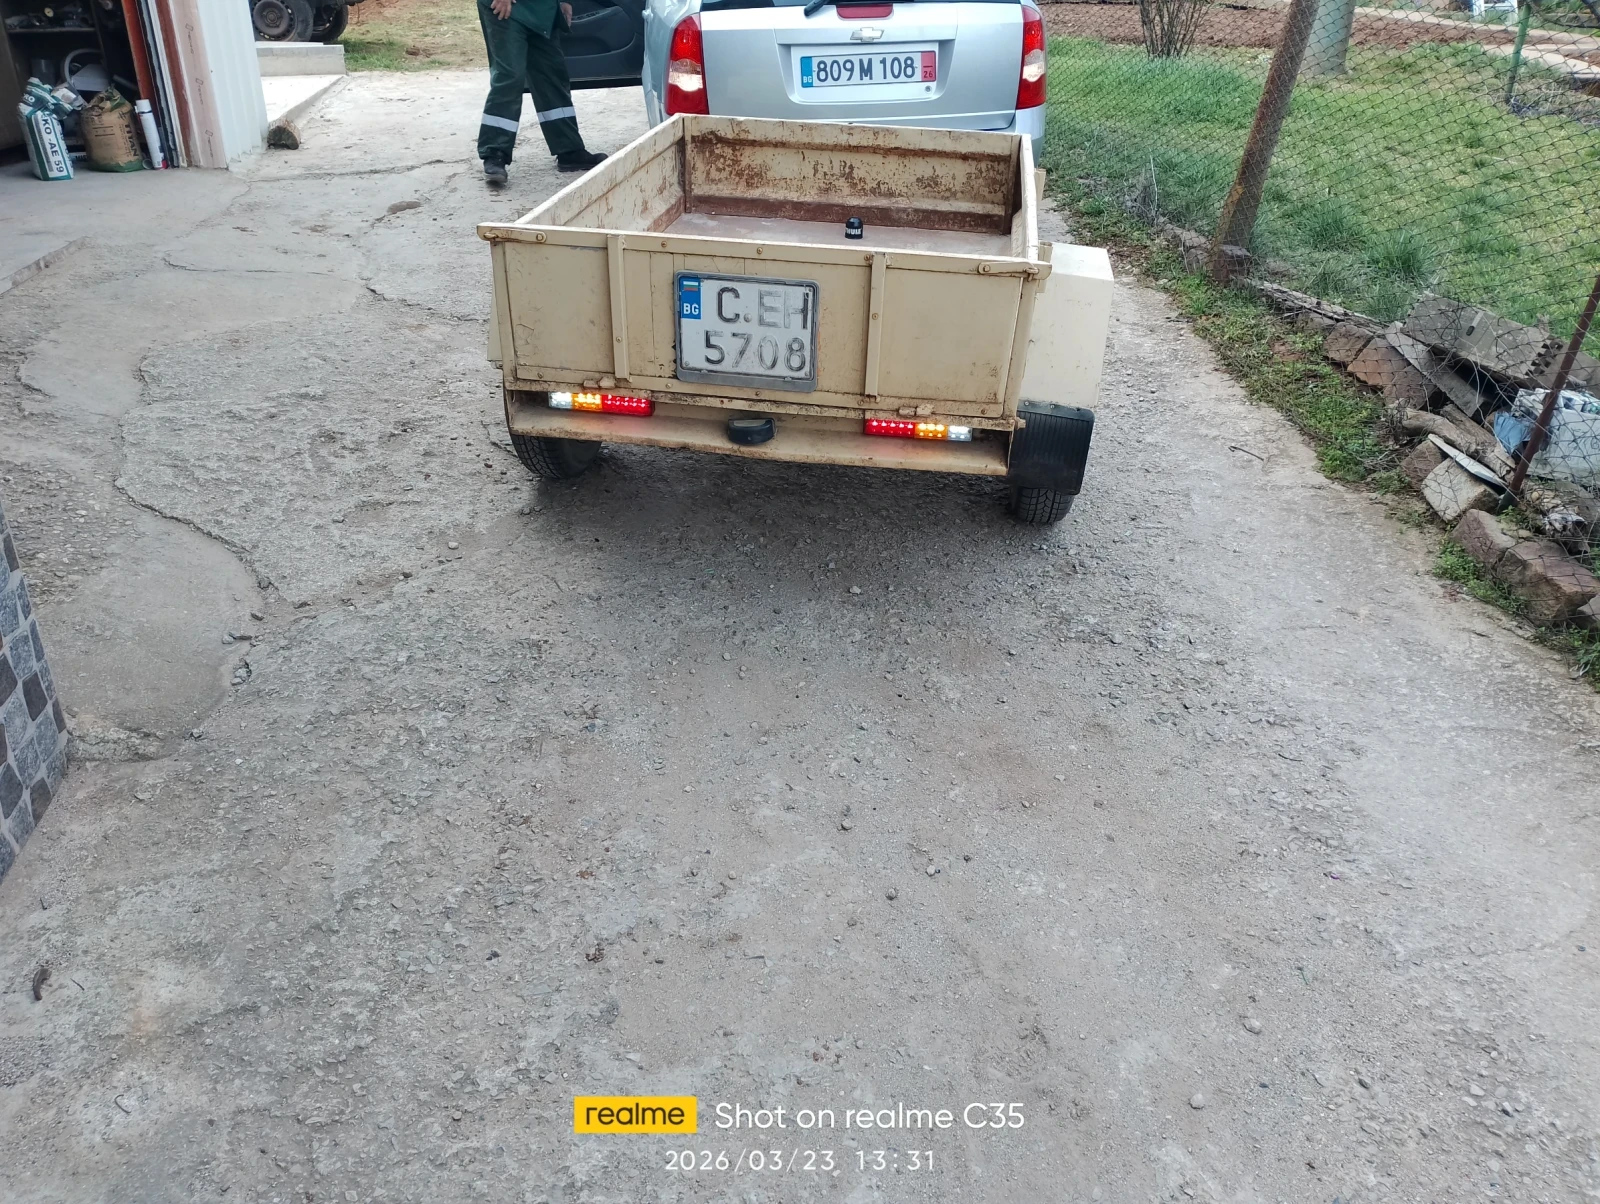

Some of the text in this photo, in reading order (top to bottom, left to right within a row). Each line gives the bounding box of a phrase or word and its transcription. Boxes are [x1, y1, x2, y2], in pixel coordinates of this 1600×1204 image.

[816, 56, 915, 82] 809 M 108
[923, 70, 933, 78] 26
[54, 159, 65, 173] 59
[683, 303, 699, 315] BG
[704, 329, 806, 372] 5708
